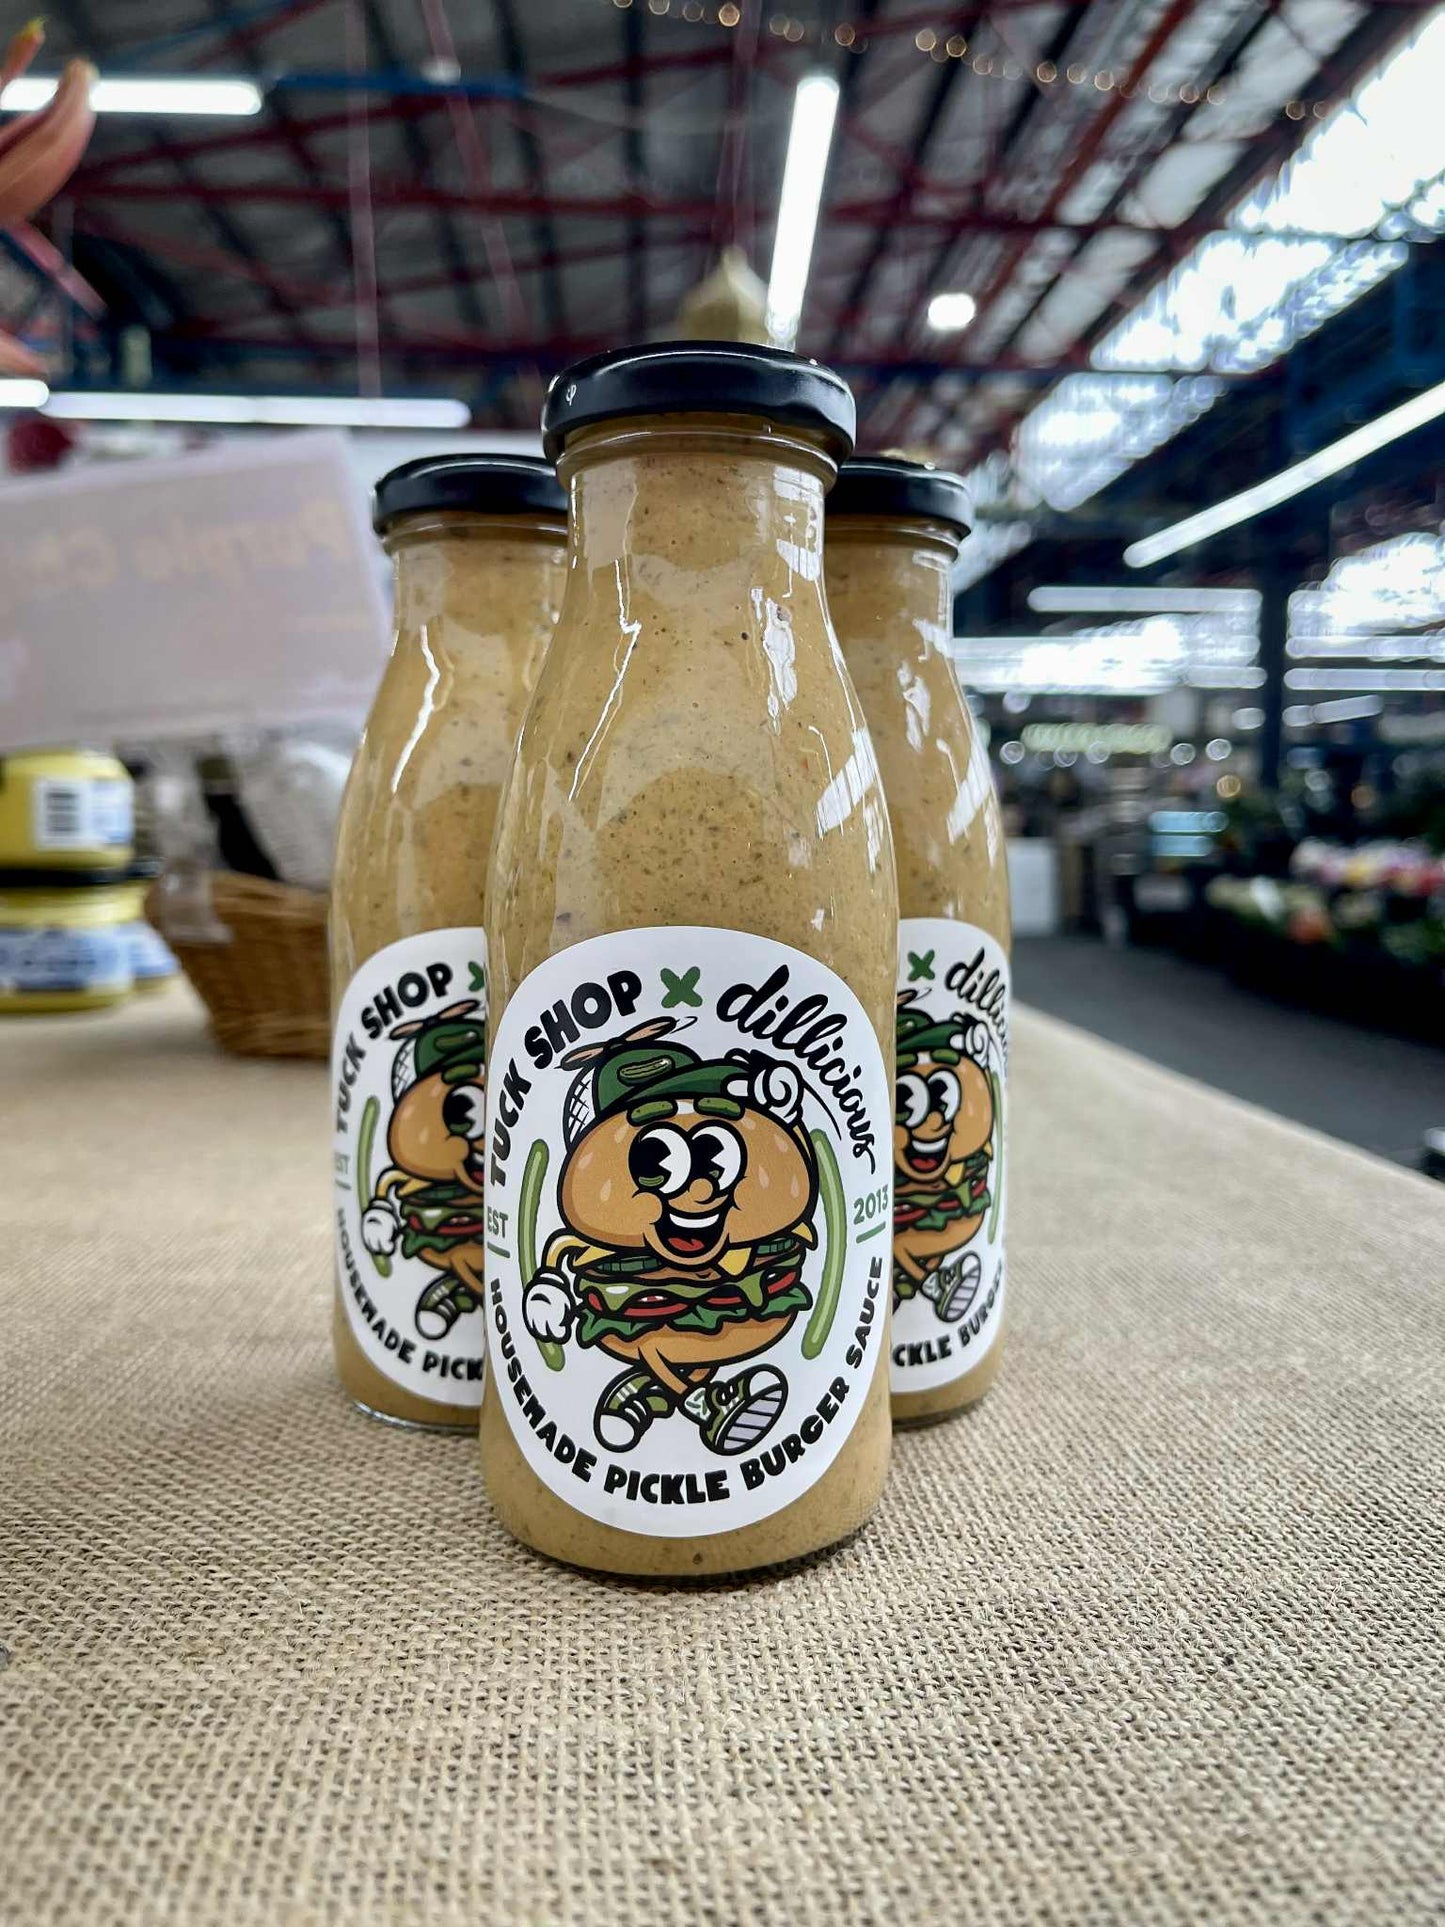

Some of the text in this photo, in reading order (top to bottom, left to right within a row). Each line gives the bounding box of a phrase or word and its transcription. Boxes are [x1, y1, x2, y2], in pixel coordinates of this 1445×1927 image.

[337, 1032, 366, 1134] TUCK
[361, 962, 453, 1040] SHOP
[490, 1058, 532, 1187] TUCK
[524, 970, 642, 1070] SHOP
[716, 964, 876, 1175] dillicious
[487, 1184, 889, 1239] EST 2013
[490, 1257, 882, 1505] HOUSEMADE PICKLE BURGER SAUCE
